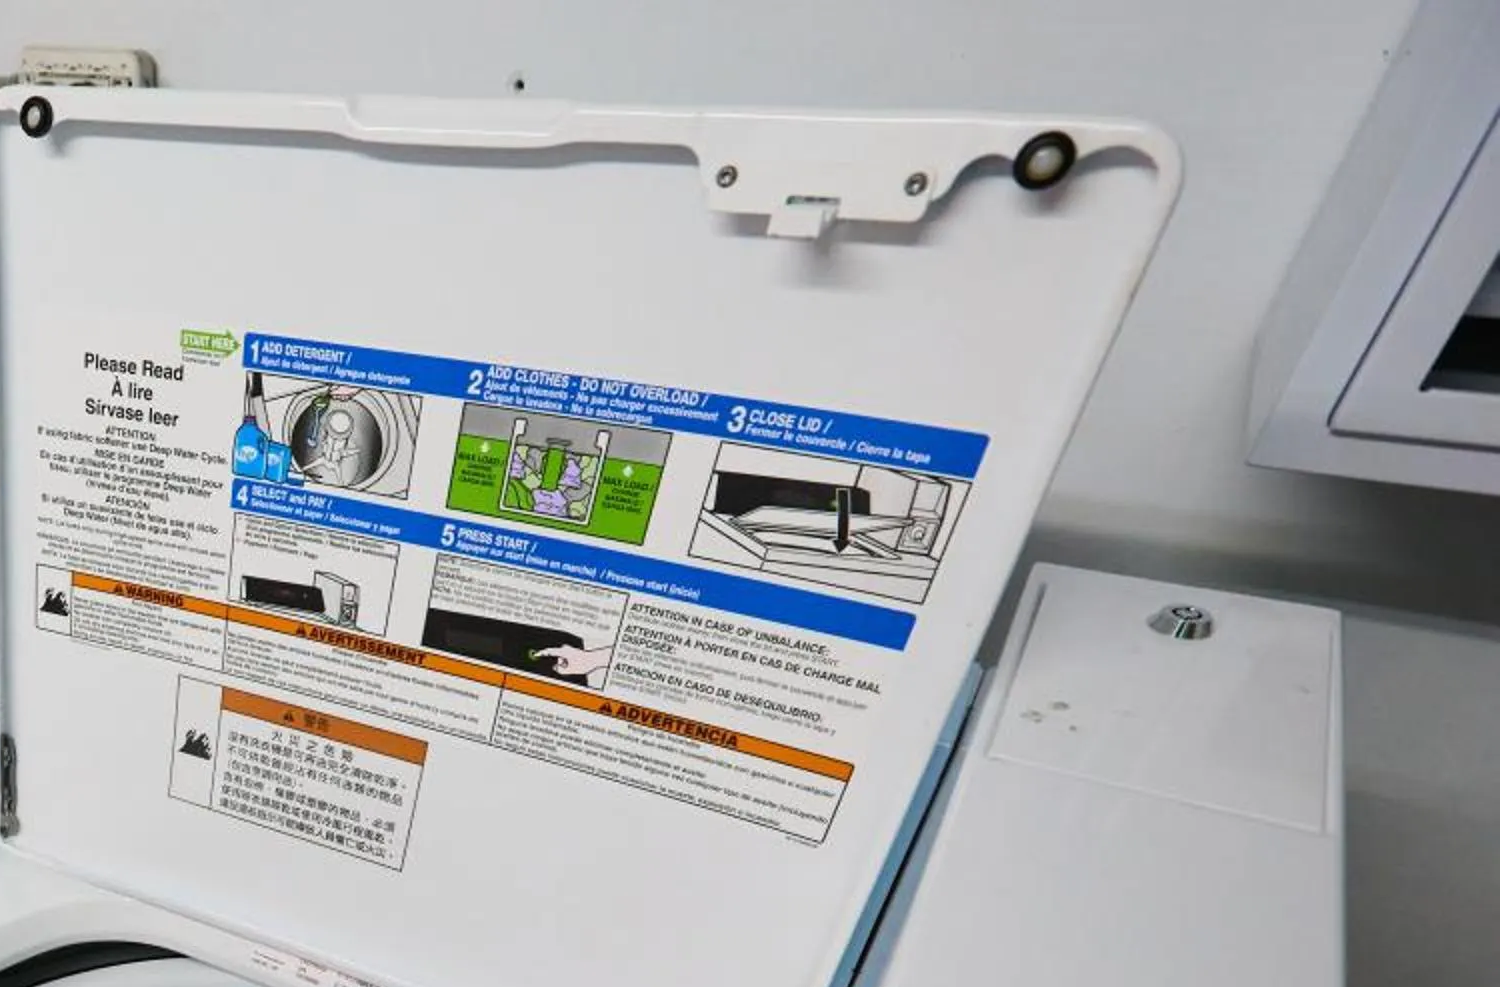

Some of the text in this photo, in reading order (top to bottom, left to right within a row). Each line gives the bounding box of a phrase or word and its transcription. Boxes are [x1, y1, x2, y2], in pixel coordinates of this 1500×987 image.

[251, 339, 260, 364] 1
[262, 342, 283, 353] ADD
[286, 344, 345, 363] DETERGENT
[84, 352, 185, 381] Please Read
[111, 375, 153, 401] À lire
[468, 370, 483, 395] 2
[488, 366, 512, 380] ADD
[514, 368, 570, 388] CLOTHES
[580, 378, 599, 393] DO
[601, 380, 627, 396] NOT
[630, 385, 699, 407] OVERLOAD
[149, 407, 179, 427] leer
[727, 406, 747, 433] 3
[750, 409, 796, 430] CLOSE
[798, 416, 821, 433] LID
[150, 443, 172, 457] Deep
[236, 485, 327, 509] 4 SELECT and PAY
[441, 524, 457, 546] 5
[458, 528, 493, 546] PRESS
[496, 535, 530, 552] START
[126, 583, 184, 607] WARNING
[630, 602, 690, 624] ATTENTION
[692, 616, 703, 627] IN
[705, 619, 736, 635] CASE
[737, 626, 752, 637] OF
[309, 625, 426, 666] AVERTISSEMENT
[624, 624, 684, 645] ATTENTION
[694, 639, 741, 658] PORTER
[741, 651, 757, 664] EN
[759, 654, 783, 670] CAS
[785, 661, 801, 674] DE
[803, 666, 854, 688] CHARGE
[856, 678, 882, 695] MAL
[667, 674, 681, 687] EN
[684, 677, 714, 695] CASO
[716, 686, 732, 699] DE
[617, 700, 740, 748] ADVERTENCIA
